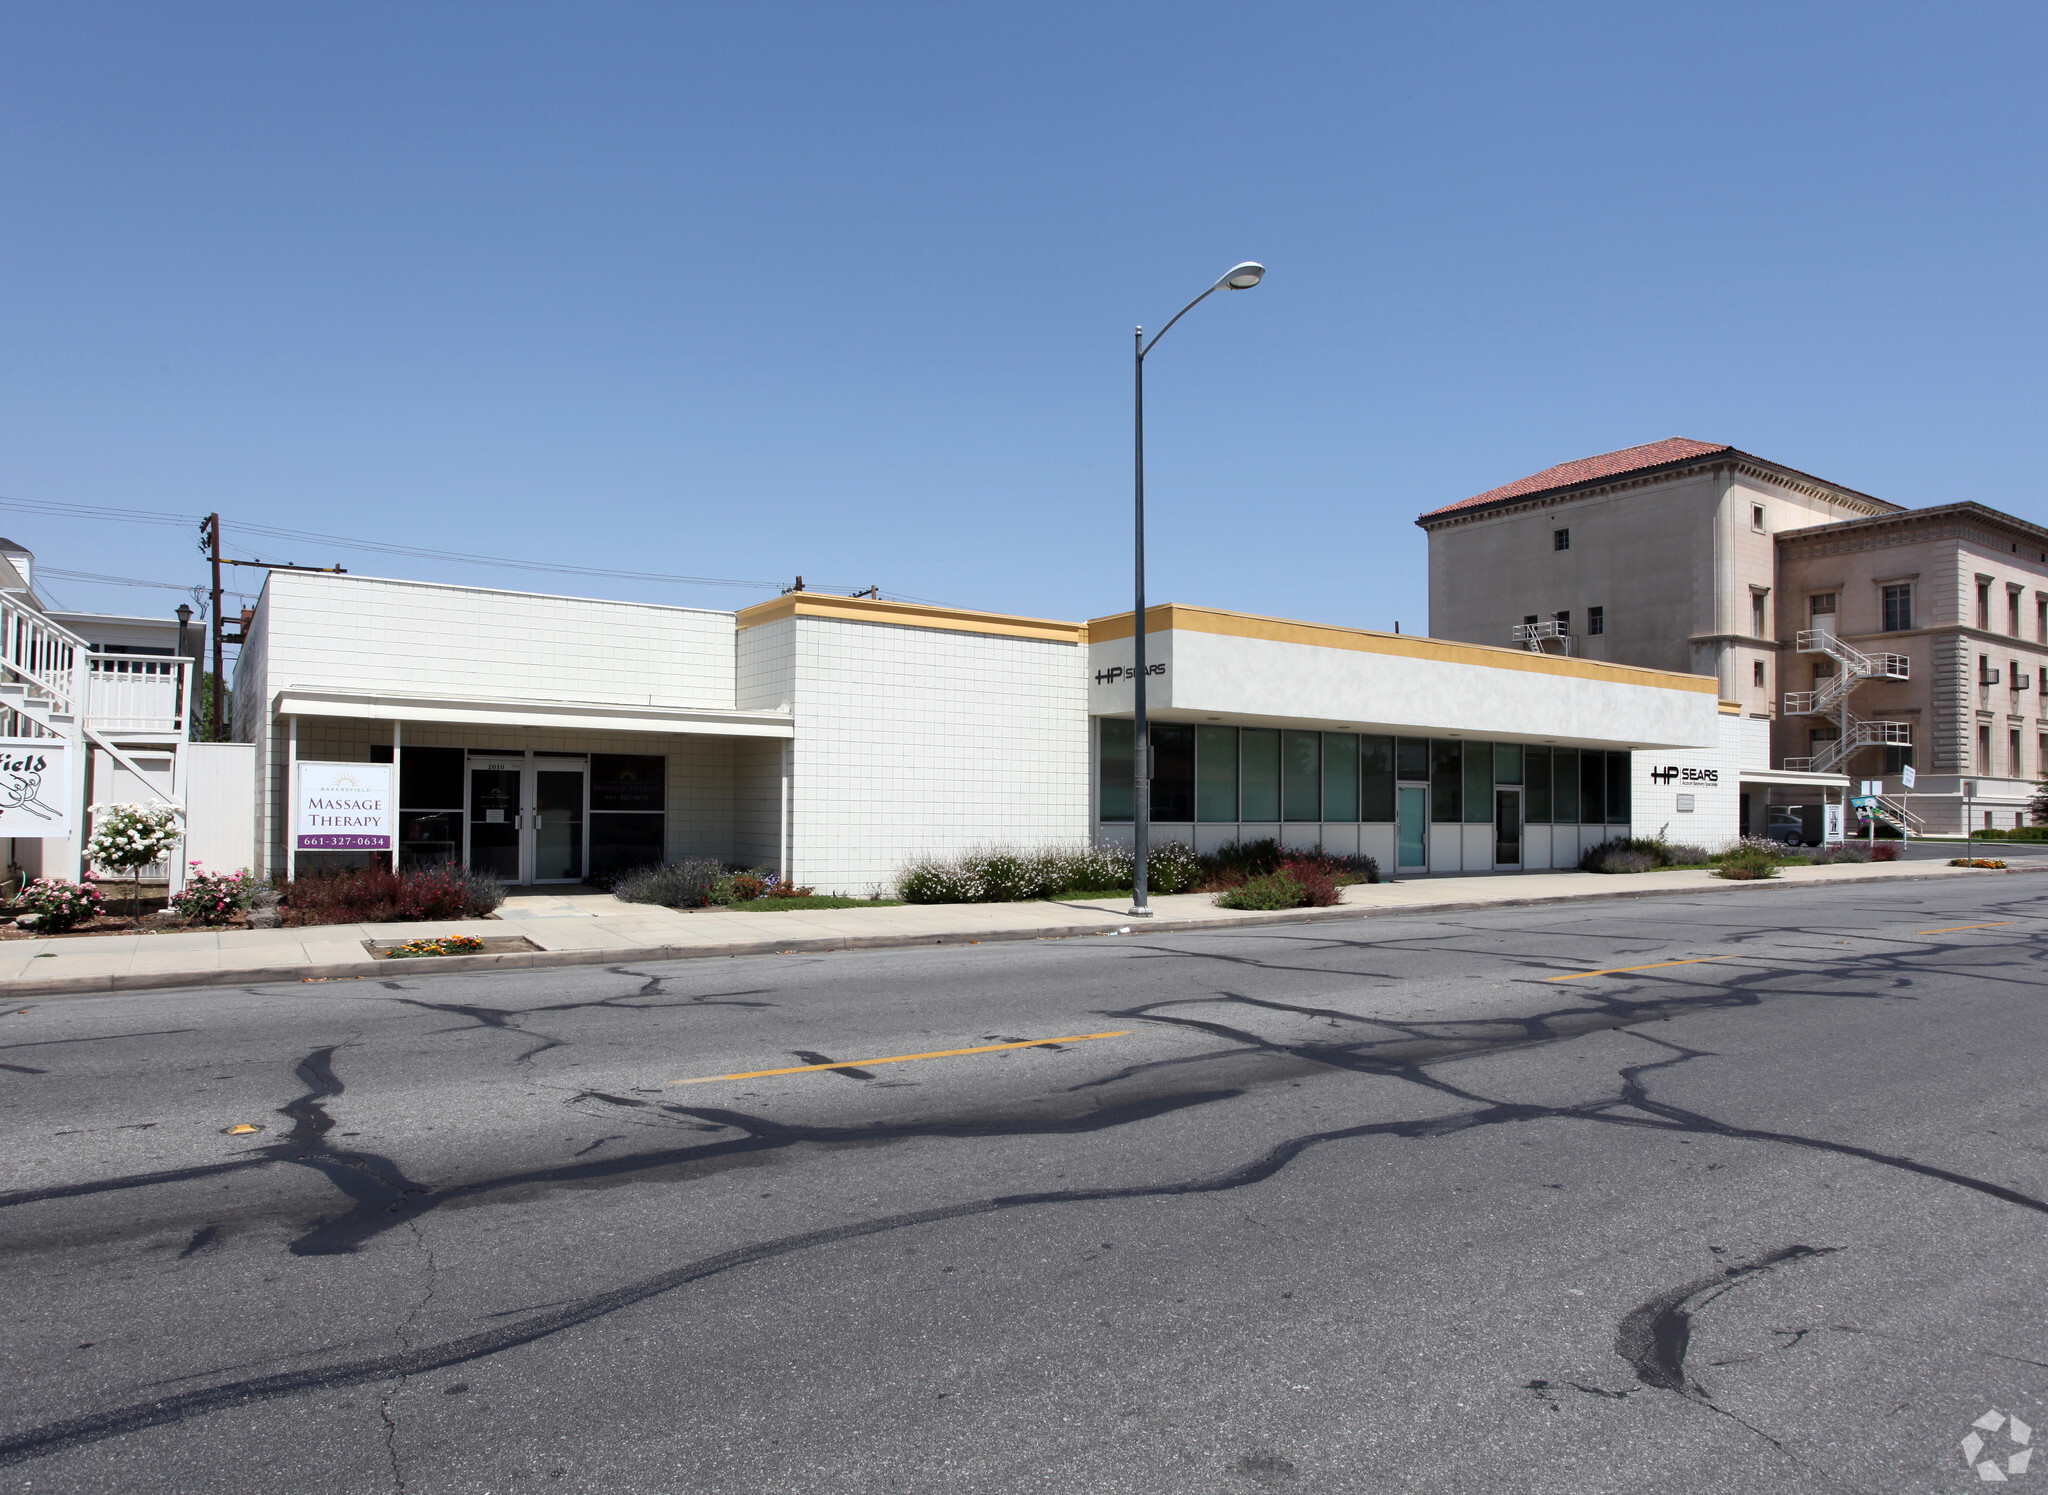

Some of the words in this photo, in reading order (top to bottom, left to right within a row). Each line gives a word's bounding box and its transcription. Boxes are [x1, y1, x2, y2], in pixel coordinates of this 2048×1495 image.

[1095, 666, 1122, 685] HP
[1126, 663, 1166, 679] SARS
[1651, 765, 1679, 785] HP
[1682, 768, 1718, 781] SEARS
[308, 797, 382, 810] MASSAGE
[308, 814, 382, 827] THERAPY
[304, 838, 384, 846] 661-327-0634
